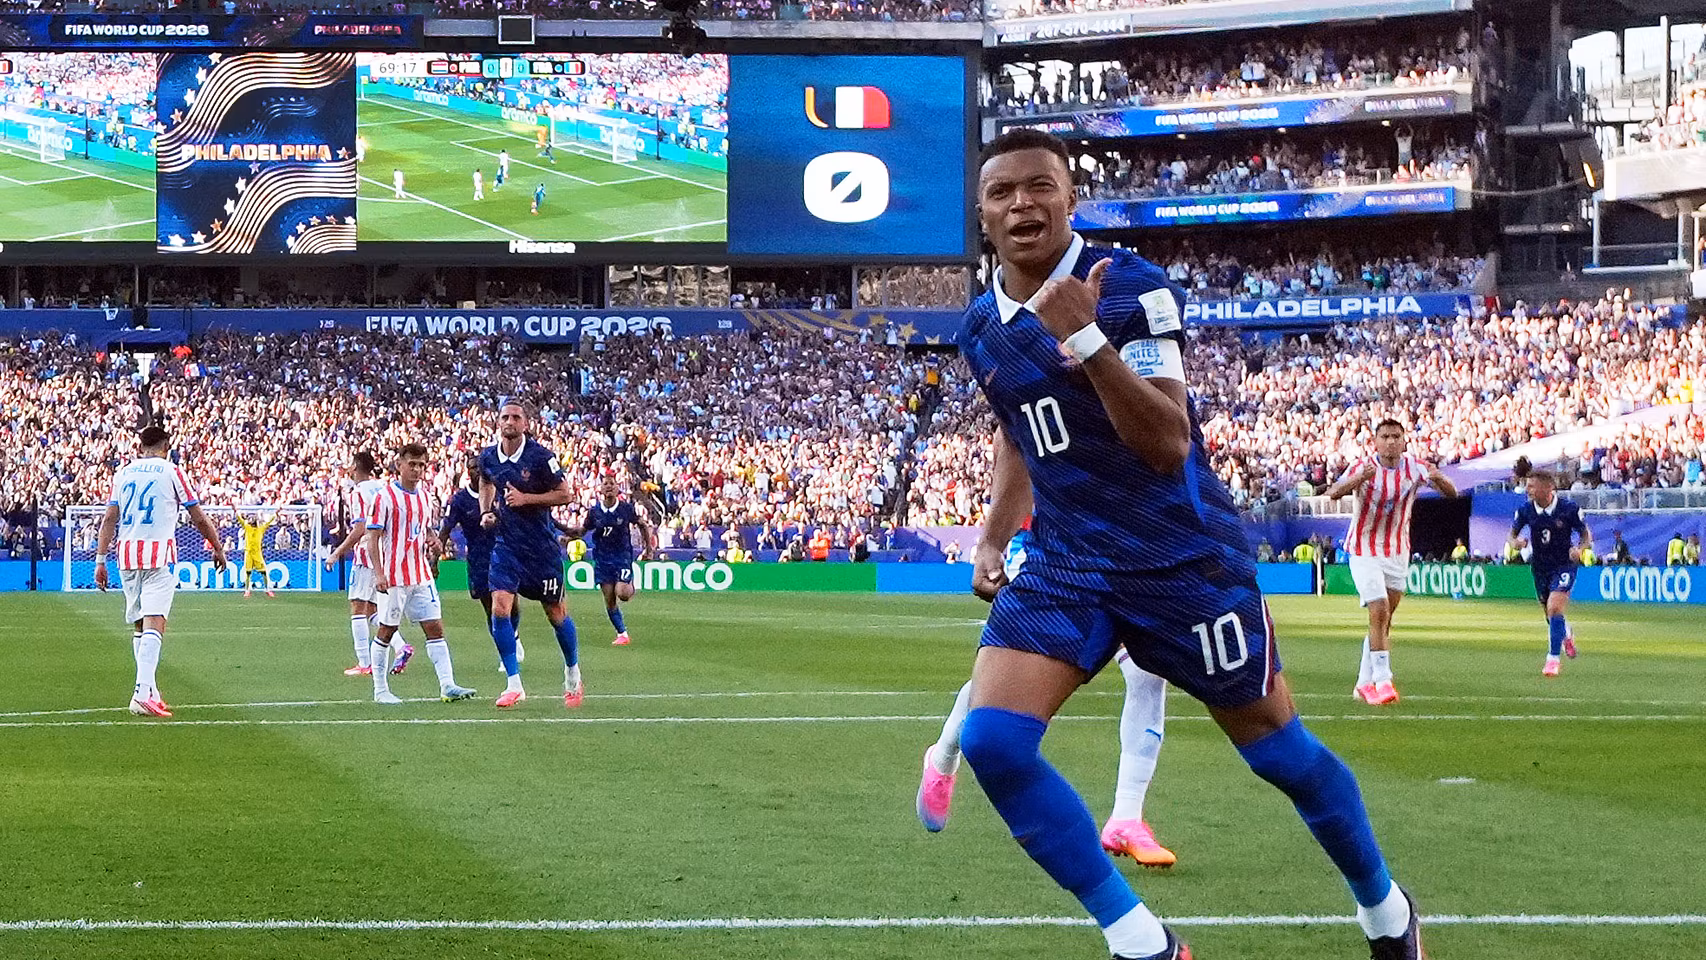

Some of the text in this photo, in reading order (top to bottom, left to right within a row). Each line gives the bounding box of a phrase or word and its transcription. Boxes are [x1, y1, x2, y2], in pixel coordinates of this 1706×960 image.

[65, 24, 209, 36] FIFA WORLD CUP 2026
[379, 62, 417, 74] 69:17
[1155, 114, 1179, 126] FIFA
[1179, 111, 1217, 125] WORLD
[1217, 110, 1240, 122] CUP
[181, 144, 332, 161] PHILADELPHIA
[1155, 206, 1179, 218] FIFA
[1179, 204, 1217, 217] WORLD
[1217, 203, 1240, 214] CUP
[508, 240, 576, 254] Hisense
[1183, 295, 1422, 320] PHILADELPHIA
[365, 316, 421, 336] FIFA
[425, 316, 520, 336] WORLD
[524, 316, 576, 337] CUP
[1020, 396, 1070, 458] 10
[122, 480, 157, 526] 24
[602, 526, 613, 537] 17
[1540, 529, 1550, 544] 3
[567, 560, 733, 591] amco
[620, 568, 631, 580] 17
[1408, 564, 1486, 596] aramco
[1558, 572, 1570, 587] 3
[542, 577, 559, 596] 14
[1599, 566, 1692, 602] aramco
[1191, 611, 1249, 676] 10
